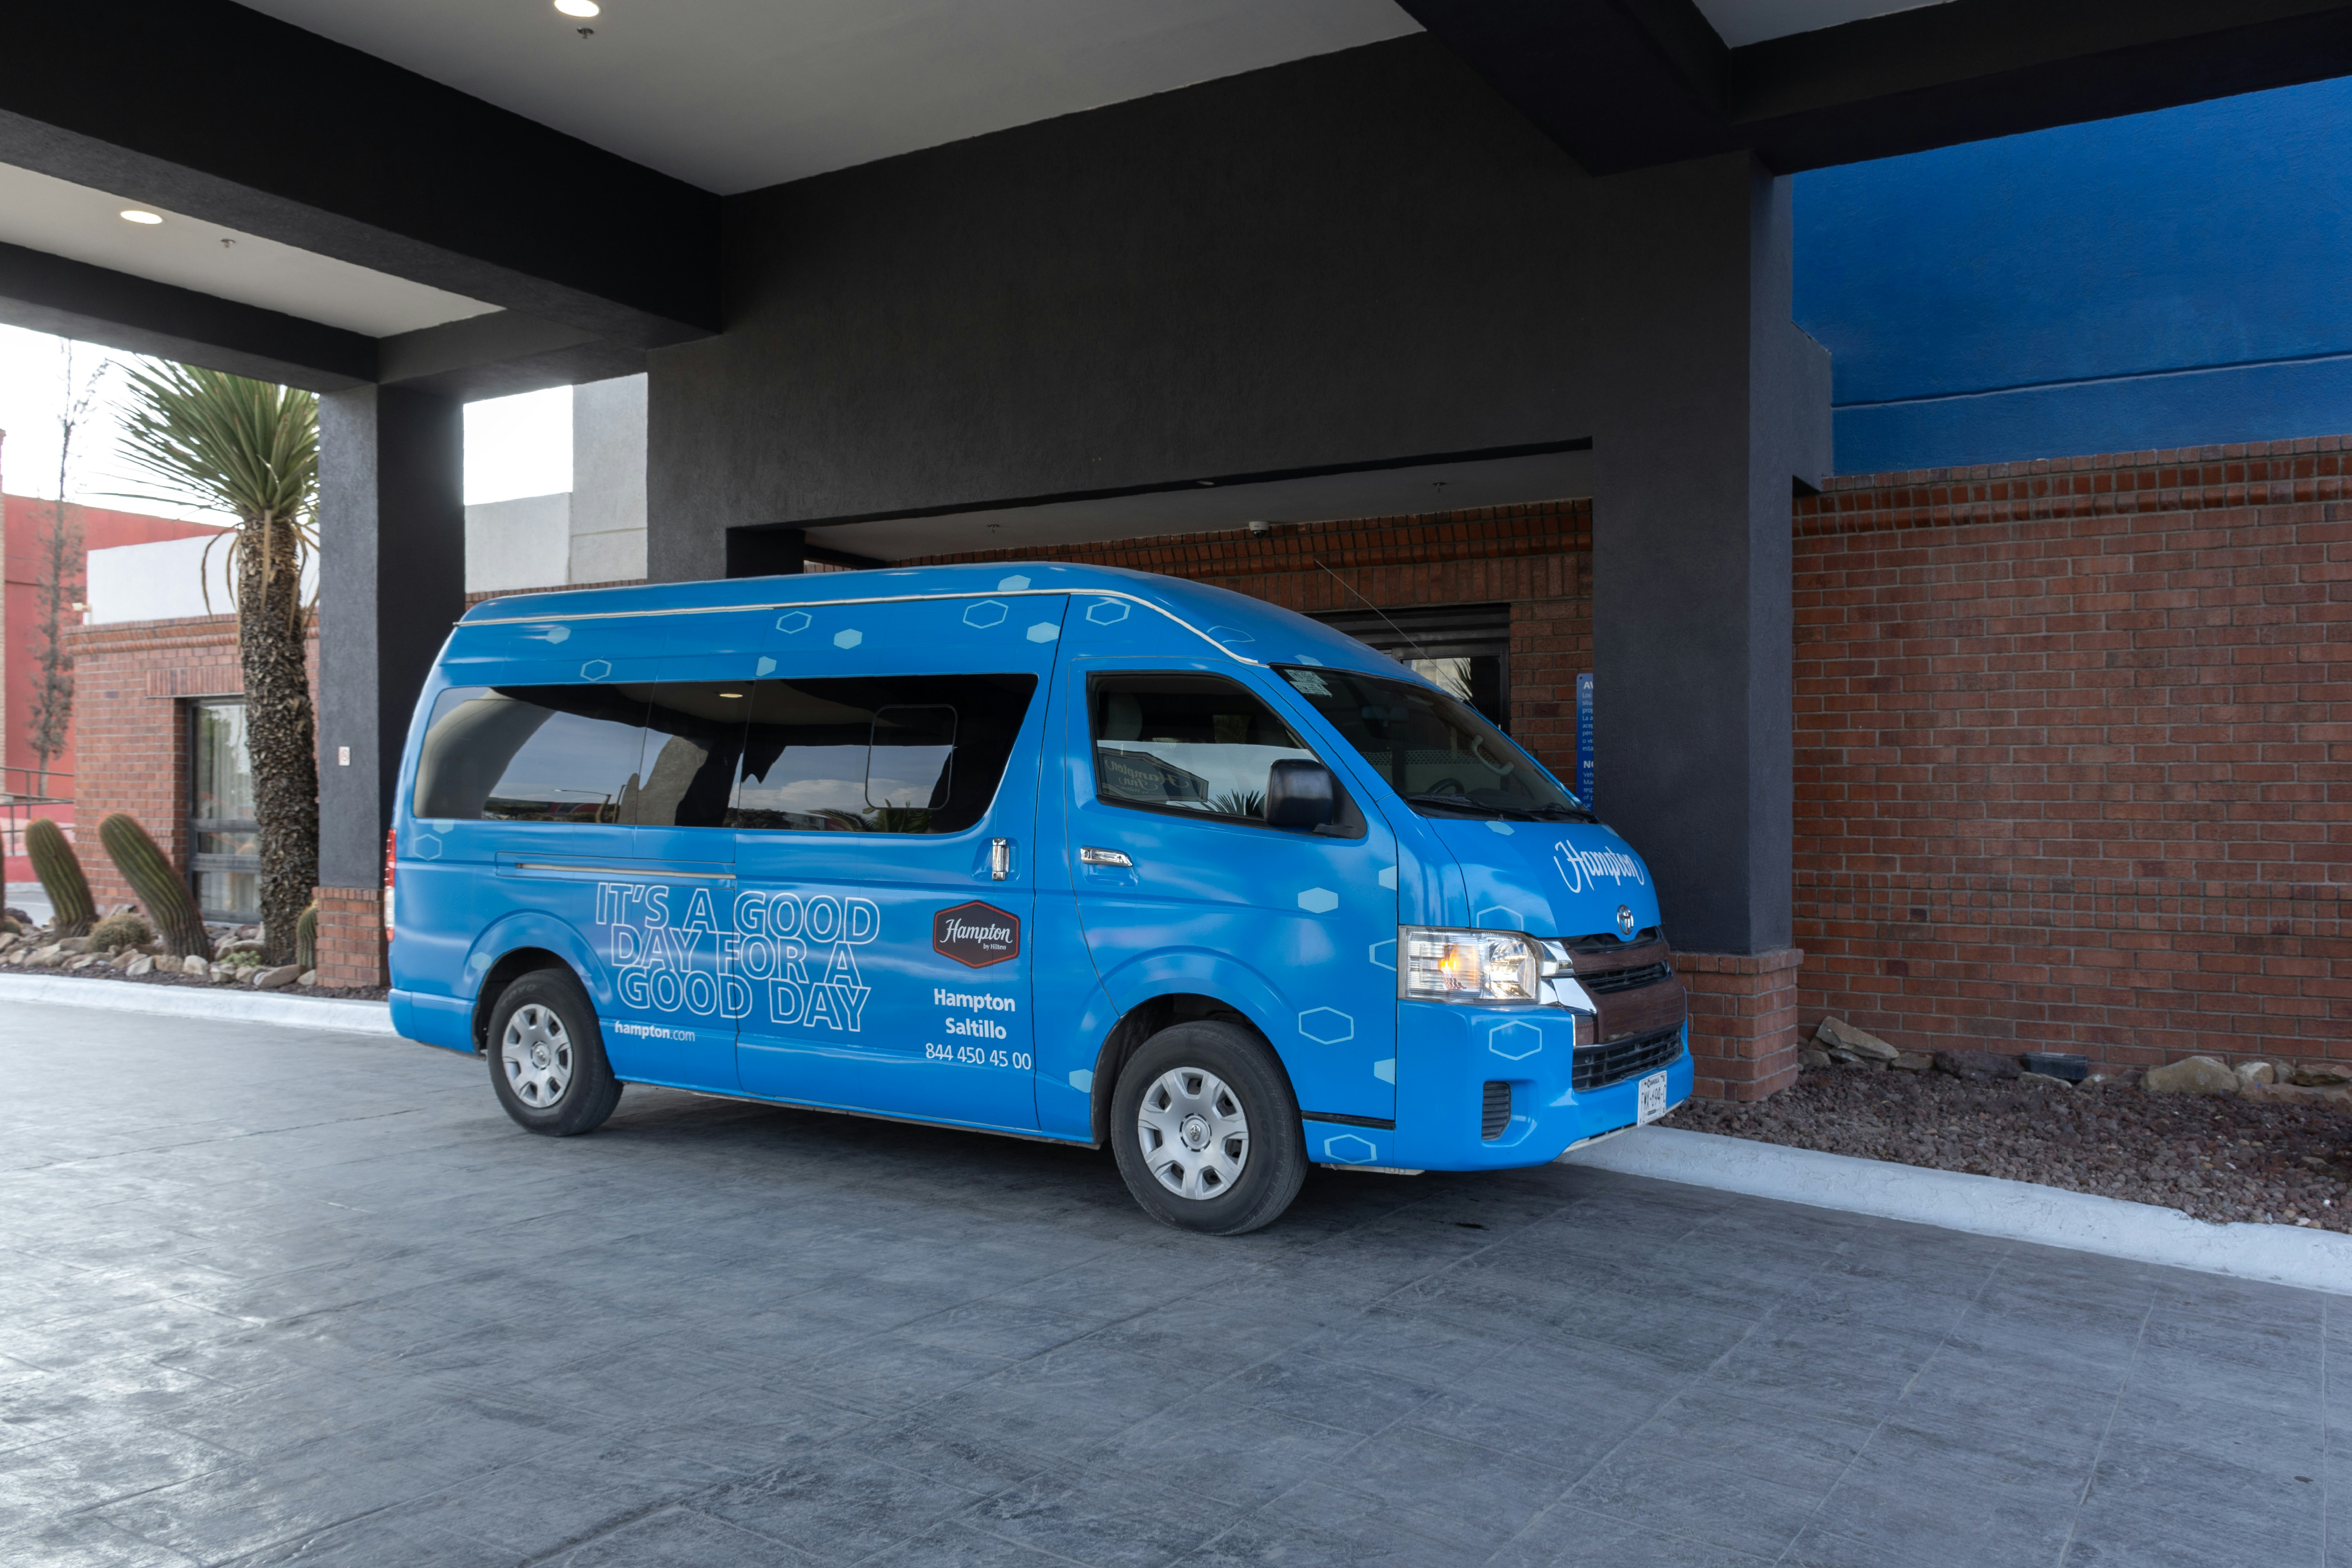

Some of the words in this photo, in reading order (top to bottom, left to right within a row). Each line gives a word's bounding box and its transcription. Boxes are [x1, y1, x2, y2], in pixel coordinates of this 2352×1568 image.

[1553, 839, 1644, 893] Hampton
[596, 882, 669, 929] IT'S
[682, 888, 719, 933] A
[733, 891, 880, 944] GOOD
[940, 918, 1013, 944] Hampton
[611, 923, 702, 973] DAY
[716, 931, 809, 984] FOR
[824, 941, 863, 989] A
[617, 966, 753, 1018] GOOD
[769, 978, 871, 1032] DAY
[934, 988, 1015, 1013] Hampton
[615, 1021, 695, 1042] hampton.com
[945, 1017, 1007, 1039] Saltillo
[926, 1043, 953, 1061] 844
[957, 1046, 985, 1064] 450
[989, 1050, 1008, 1067] 45
[1012, 1052, 1031, 1070] 00
